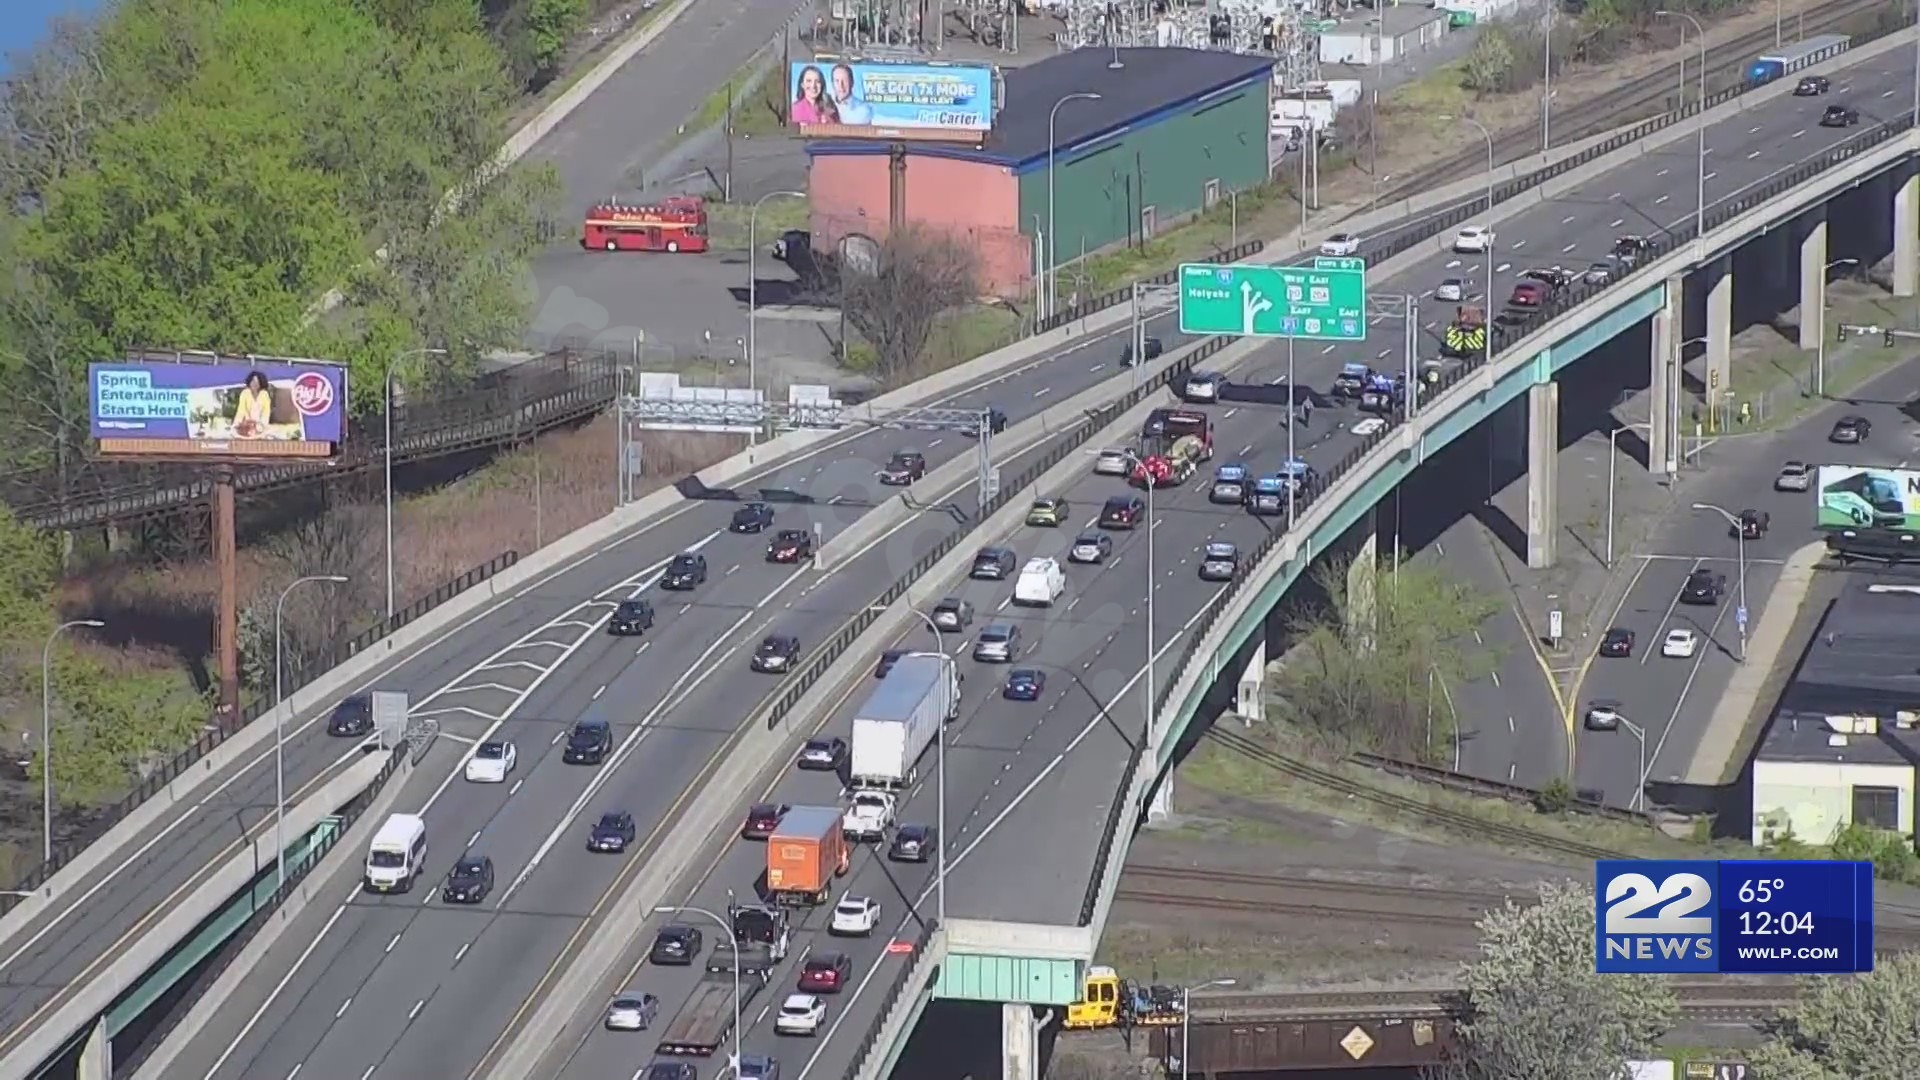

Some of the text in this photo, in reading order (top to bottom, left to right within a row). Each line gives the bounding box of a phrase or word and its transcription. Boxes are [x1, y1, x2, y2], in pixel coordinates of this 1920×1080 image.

[864, 80, 887, 94] WE
[888, 81, 914, 95] GOT
[936, 83, 977, 97] MORE
[100, 374, 148, 388] Spring
[101, 389, 189, 404] Entertaining
[101, 403, 186, 416] Starts Here!
